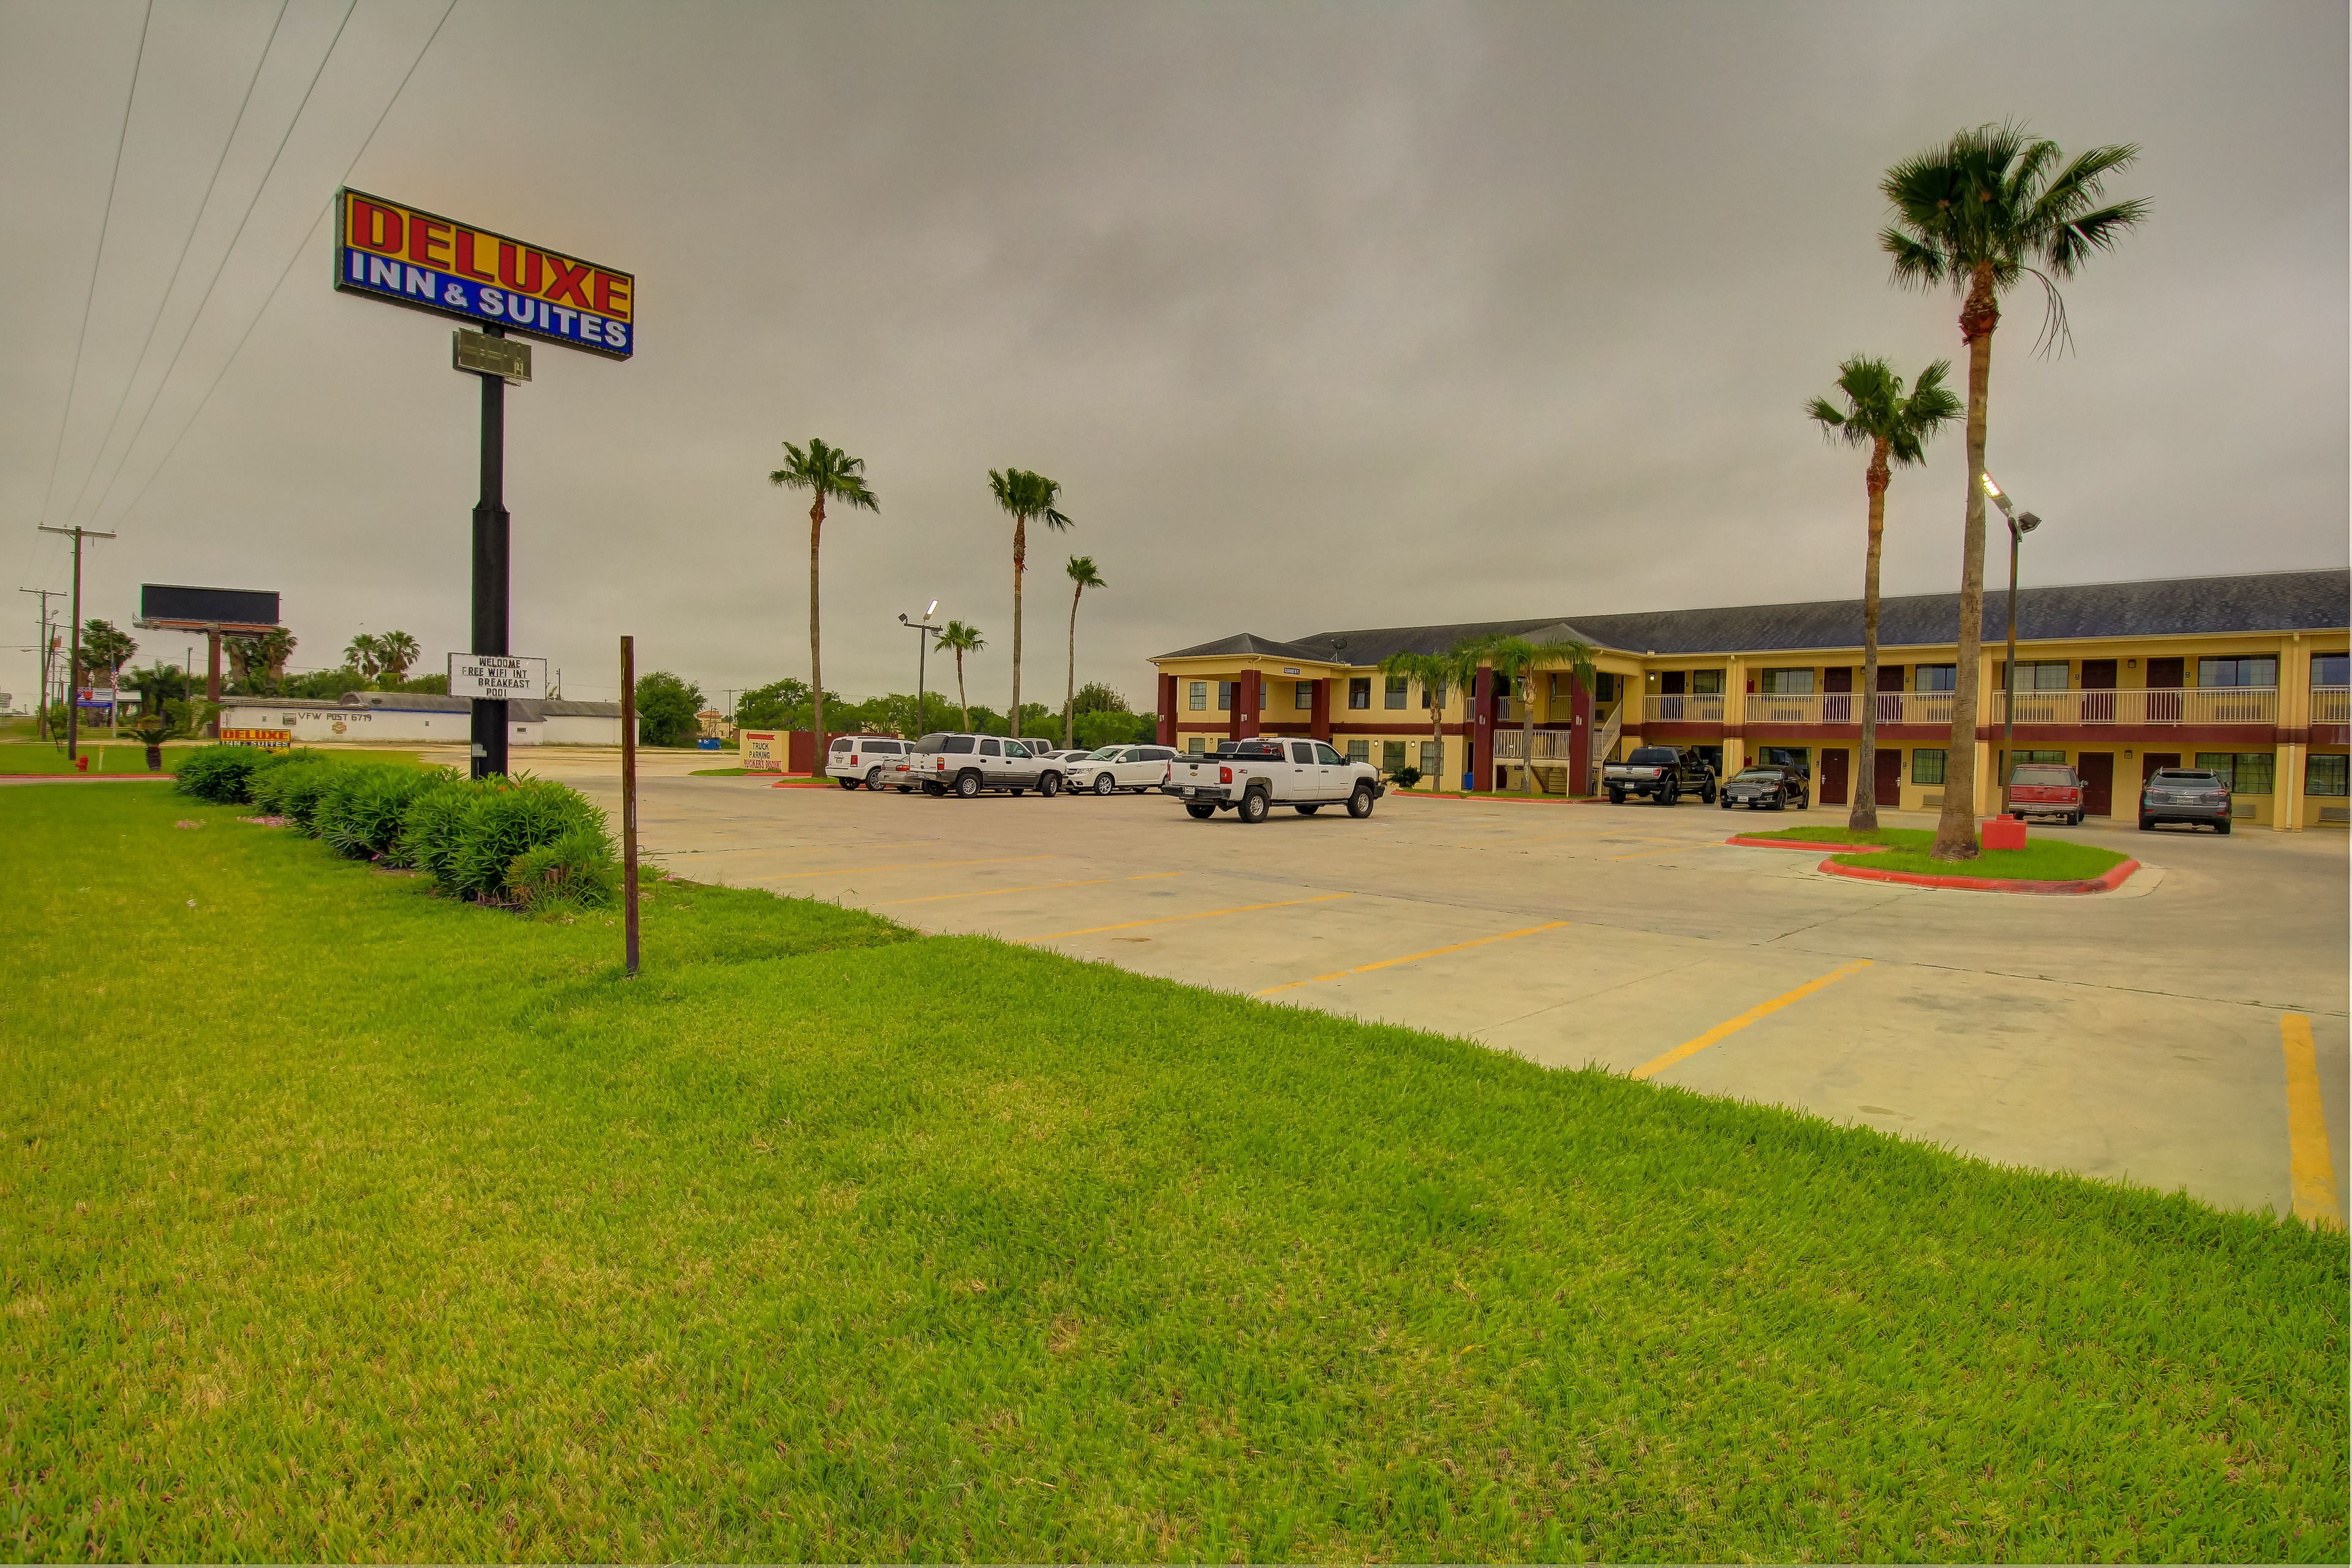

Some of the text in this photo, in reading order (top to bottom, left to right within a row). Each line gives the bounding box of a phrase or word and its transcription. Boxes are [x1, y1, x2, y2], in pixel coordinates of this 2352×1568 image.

[352, 198, 628, 318] DELUXE
[352, 251, 627, 348] INN & SUITES
[462, 666, 484, 676] FREE
[488, 668, 507, 677] WIFI
[478, 677, 530, 688] BREAKFAST
[222, 730, 288, 740] DELUXE
[752, 742, 769, 750] TRUCK
[748, 750, 770, 760] PARKING
